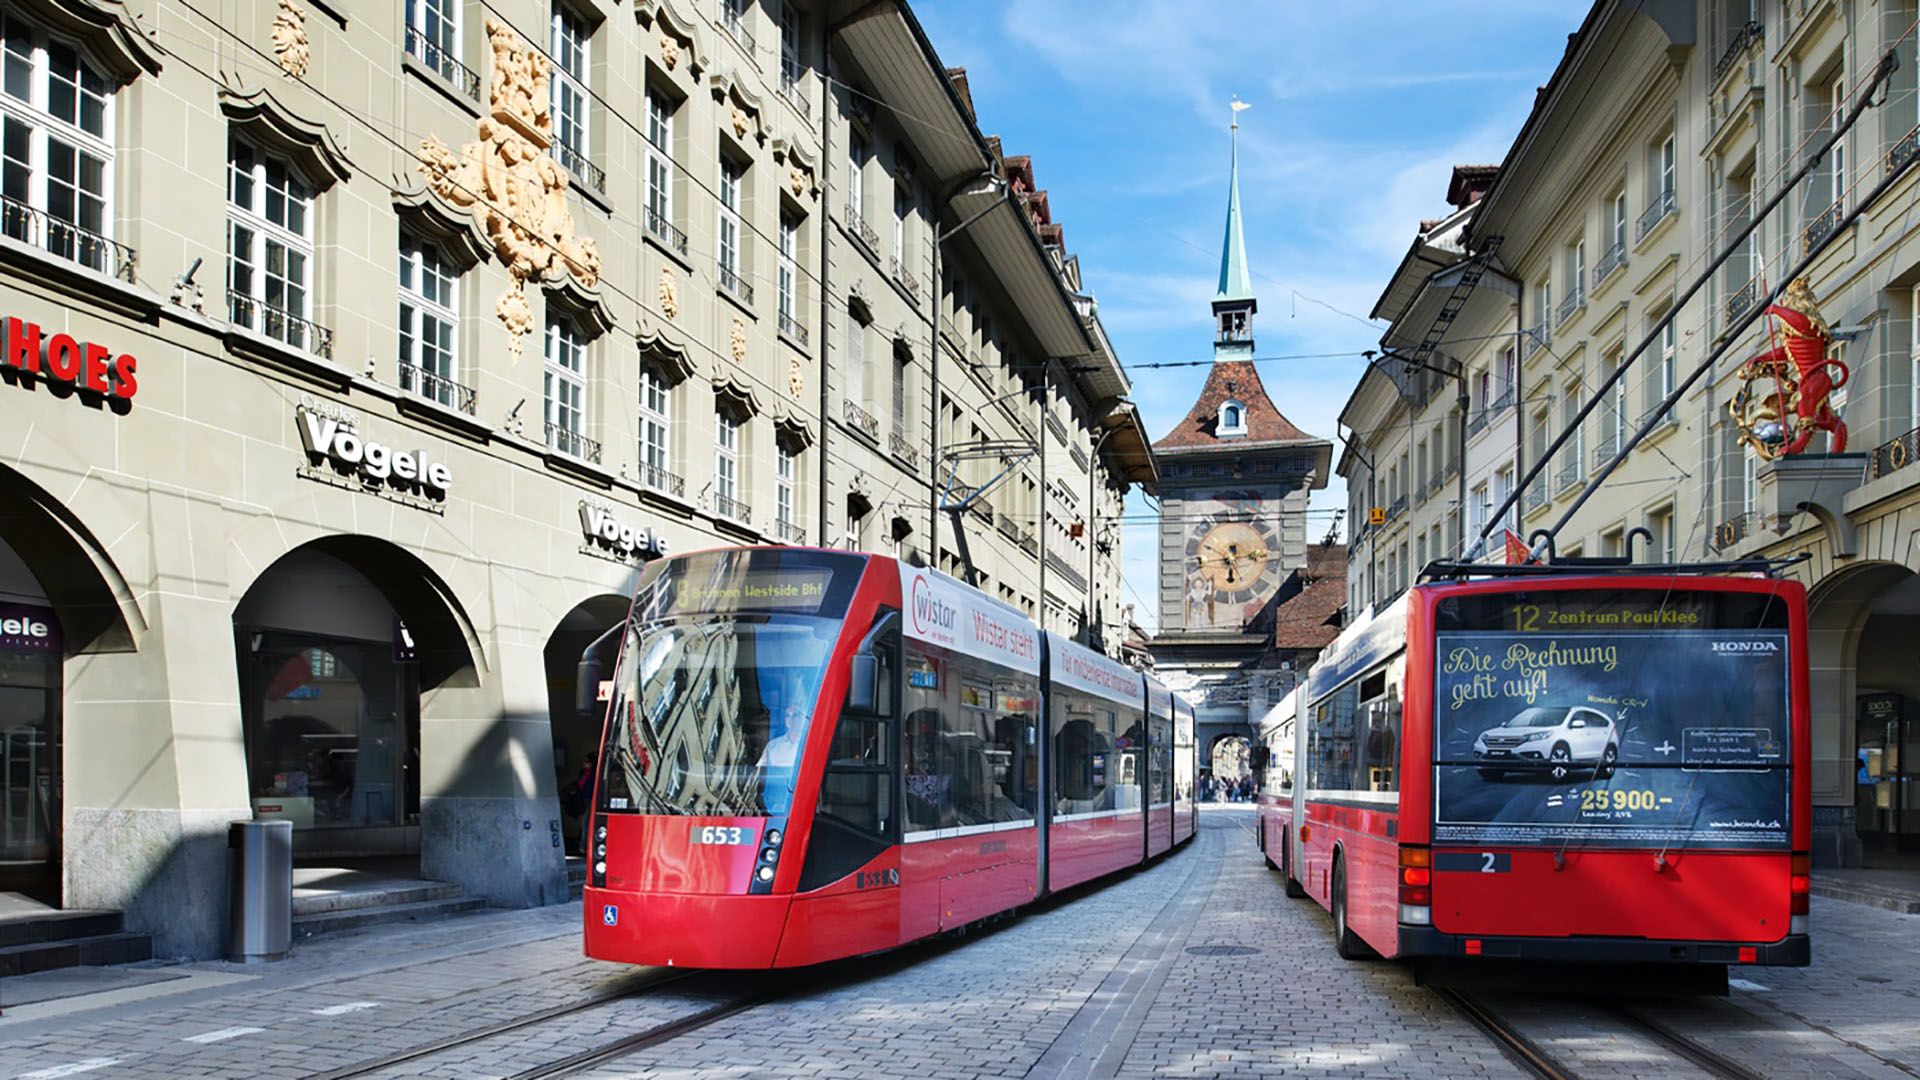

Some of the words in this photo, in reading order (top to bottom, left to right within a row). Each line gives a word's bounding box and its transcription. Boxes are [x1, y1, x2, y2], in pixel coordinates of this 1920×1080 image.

[304, 411, 453, 490] Vögele
[586, 506, 669, 555] Vögele
[745, 584, 799, 598] Westside
[802, 583, 823, 596] Bhf
[916, 590, 957, 631] wistar
[1512, 605, 1540, 632] 12
[1548, 611, 1619, 624] Zentrum
[1622, 610, 1657, 624] Paul
[1662, 610, 1698, 624] Klee
[0, 616, 49, 638] ele
[1444, 647, 1497, 674] Die
[1502, 641, 1619, 677] Rechnung
[1711, 641, 1779, 652] HONDA
[1450, 674, 1498, 710] geht
[1503, 669, 1549, 705] auf!
[701, 826, 742, 846] 653
[1481, 853, 1496, 874] 2
